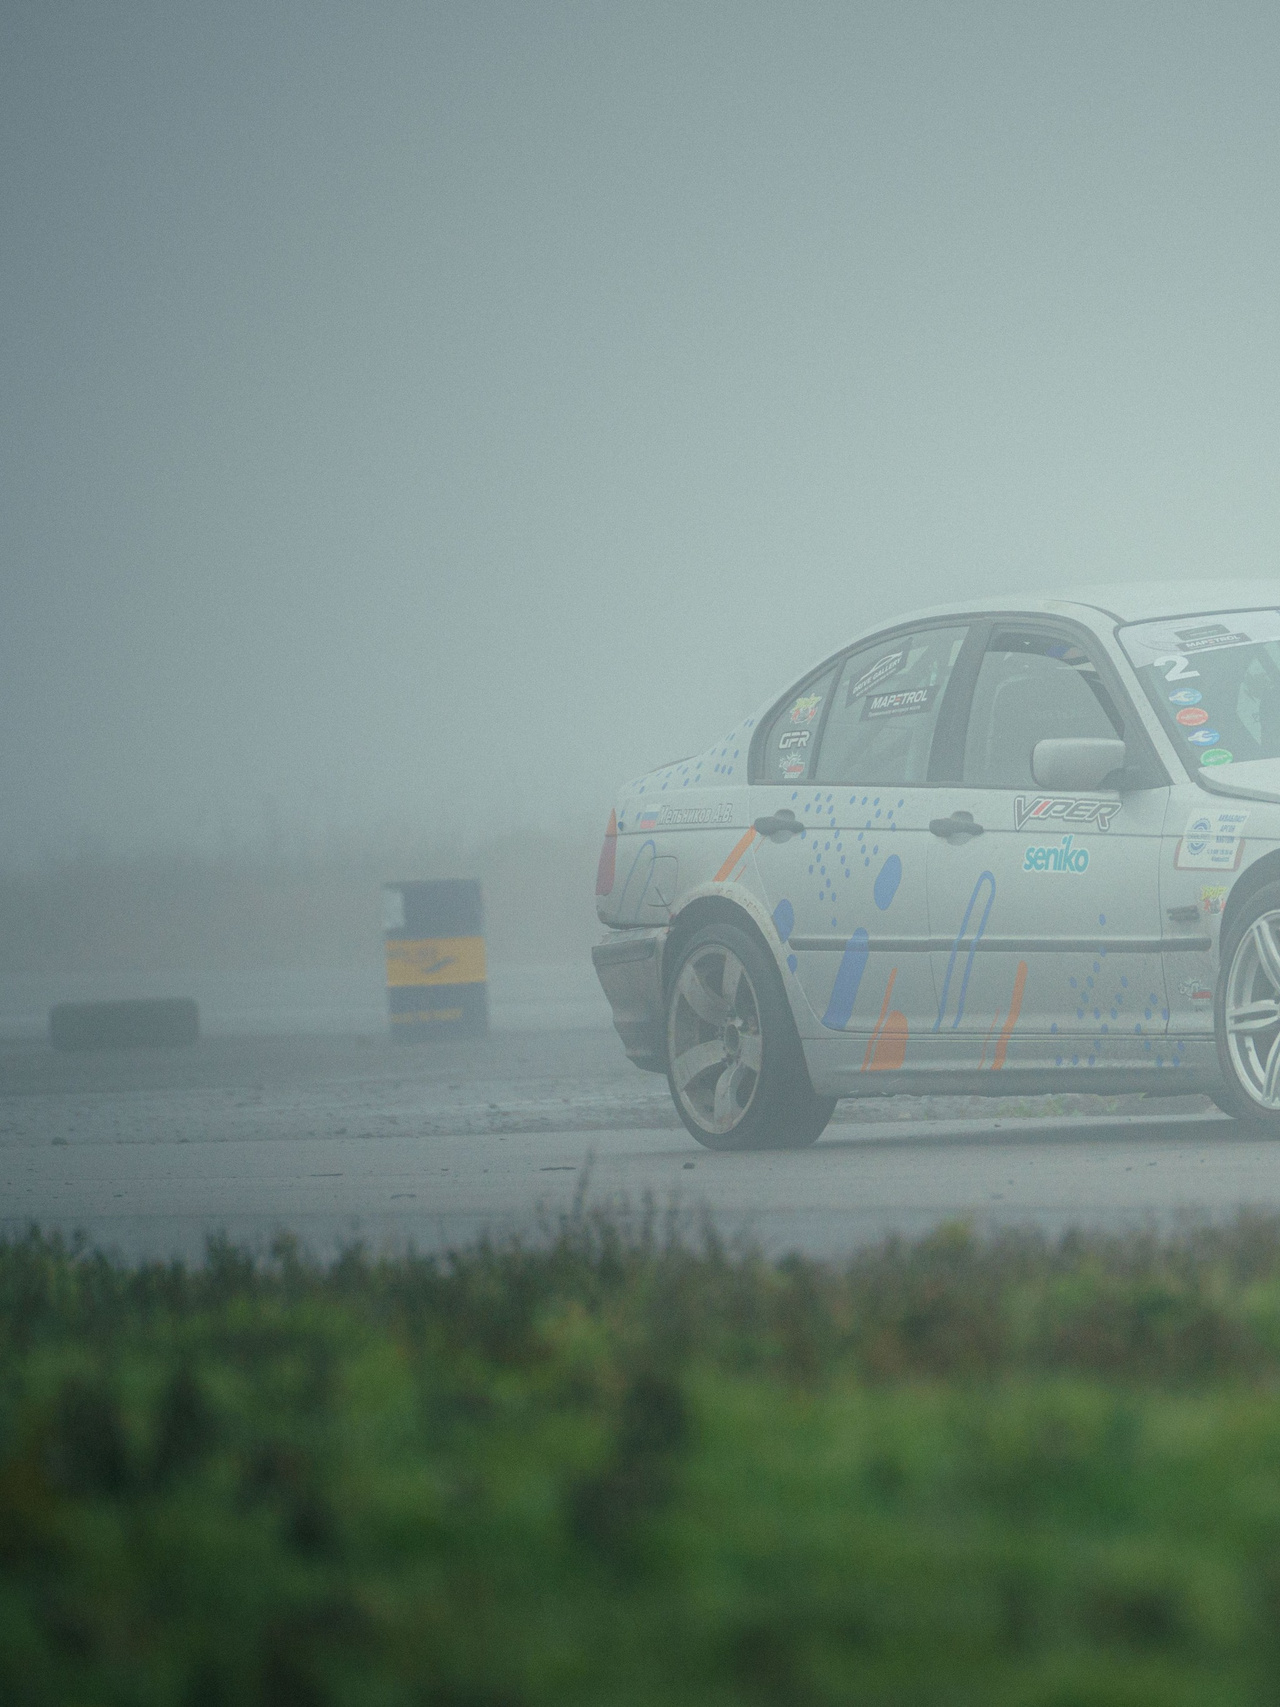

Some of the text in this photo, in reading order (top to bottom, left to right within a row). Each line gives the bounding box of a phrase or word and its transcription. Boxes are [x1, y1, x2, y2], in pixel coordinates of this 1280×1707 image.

[1186, 635, 1241, 648] MAPETROL
[852, 678, 872, 695] DRIVE
[873, 656, 902, 681] GALLERY
[1153, 655, 1200, 682] 2
[870, 689, 928, 709] MAPETROL
[1014, 795, 1123, 832] VIPER
[1023, 834, 1090, 873] seniko
